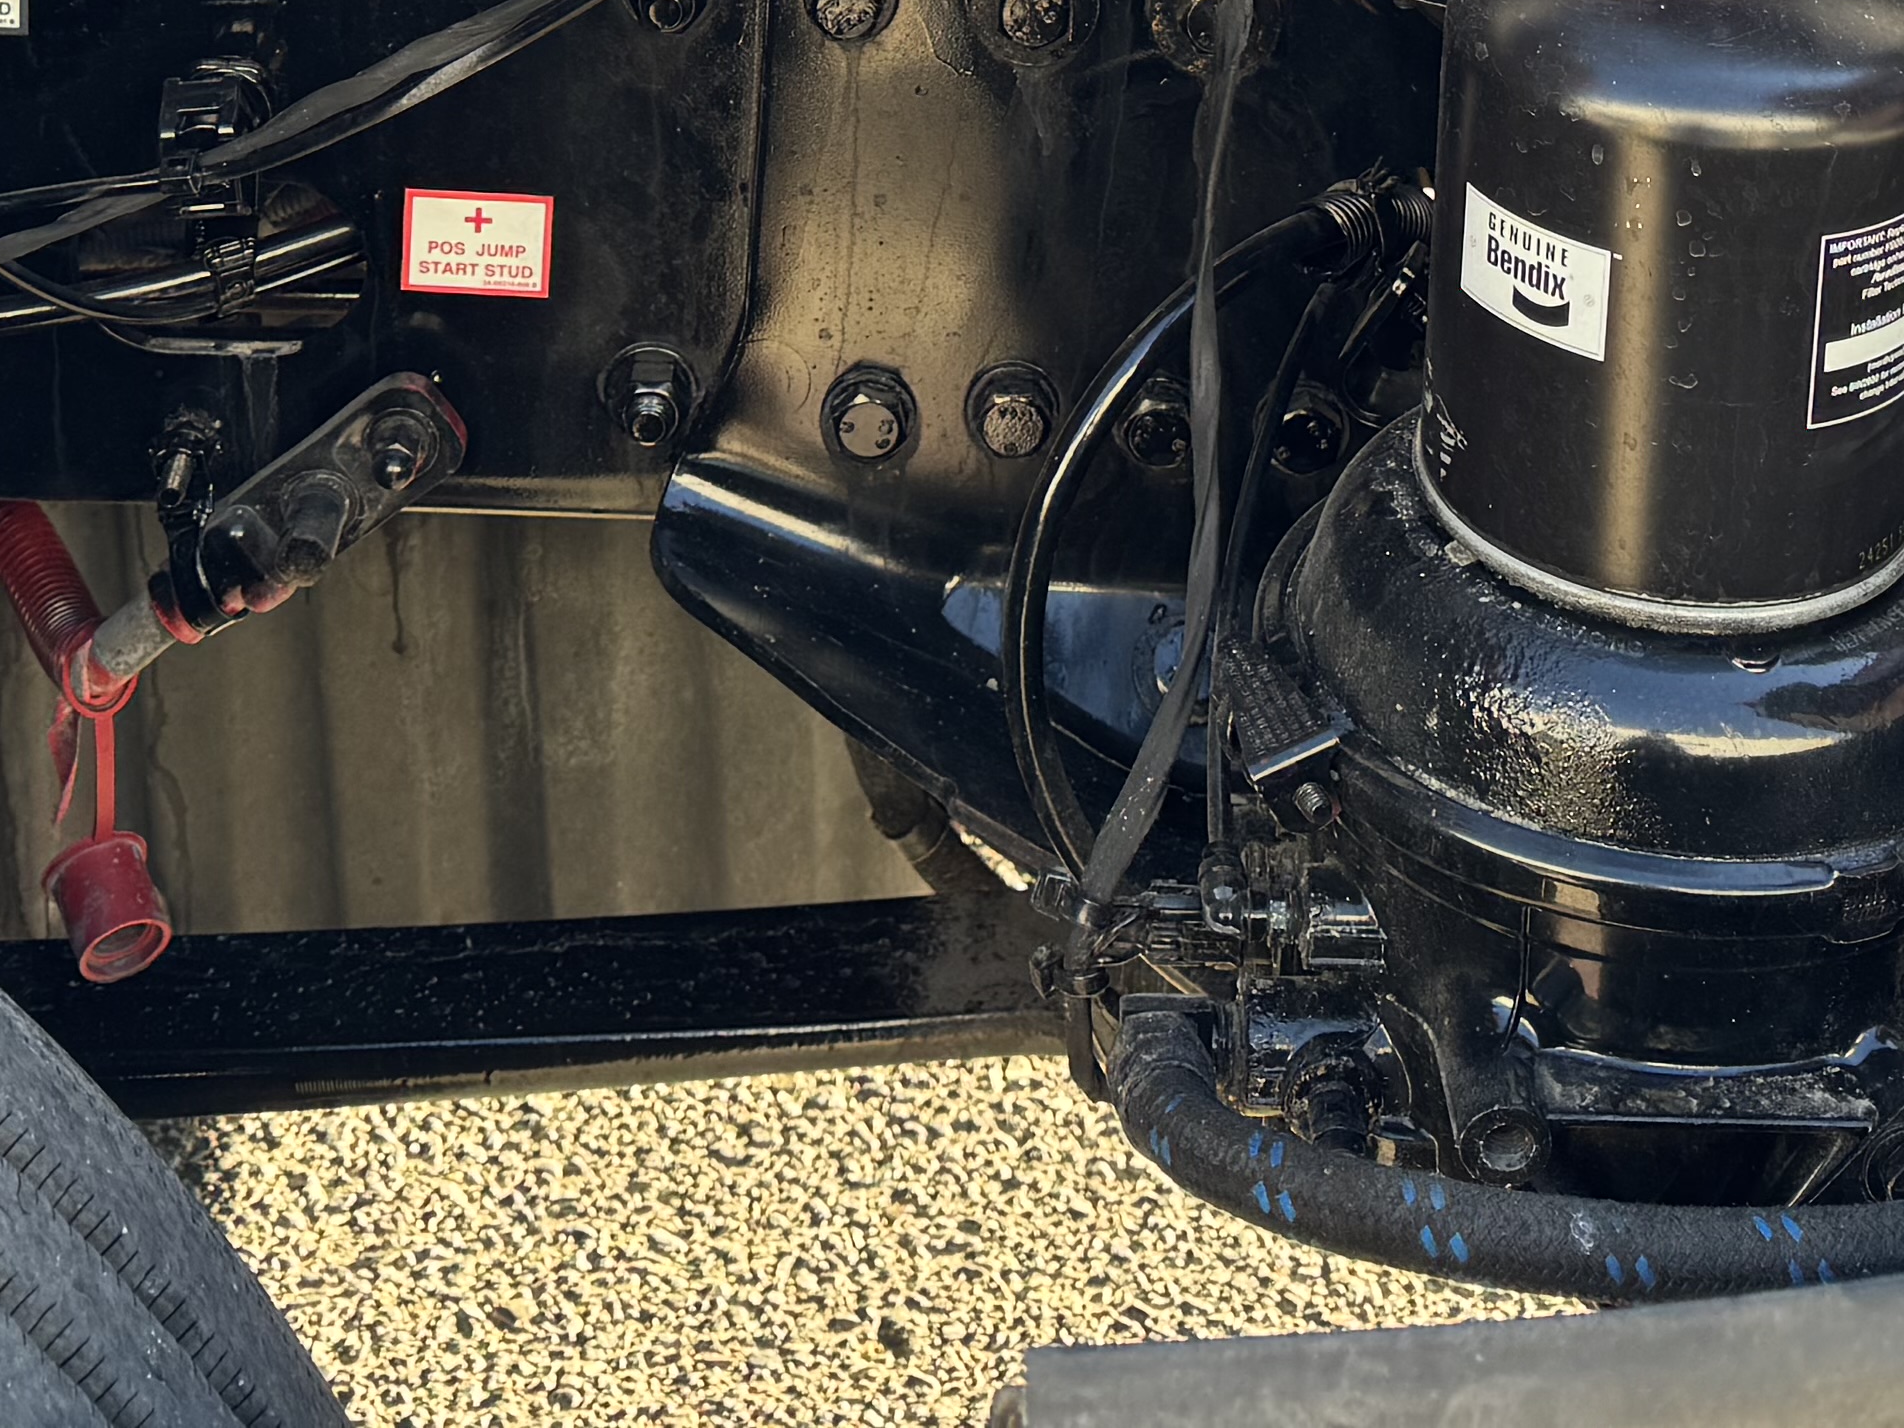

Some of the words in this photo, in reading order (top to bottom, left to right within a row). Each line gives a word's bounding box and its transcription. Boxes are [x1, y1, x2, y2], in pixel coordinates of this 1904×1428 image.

[427, 240, 466, 256] POS
[475, 243, 527, 259] JUMP
[1488, 211, 1569, 268] GENUINE
[418, 260, 479, 277] START
[484, 263, 534, 279] STUD
[1486, 233, 1567, 301] Bendix
[1850, 306, 1901, 336] Installation
